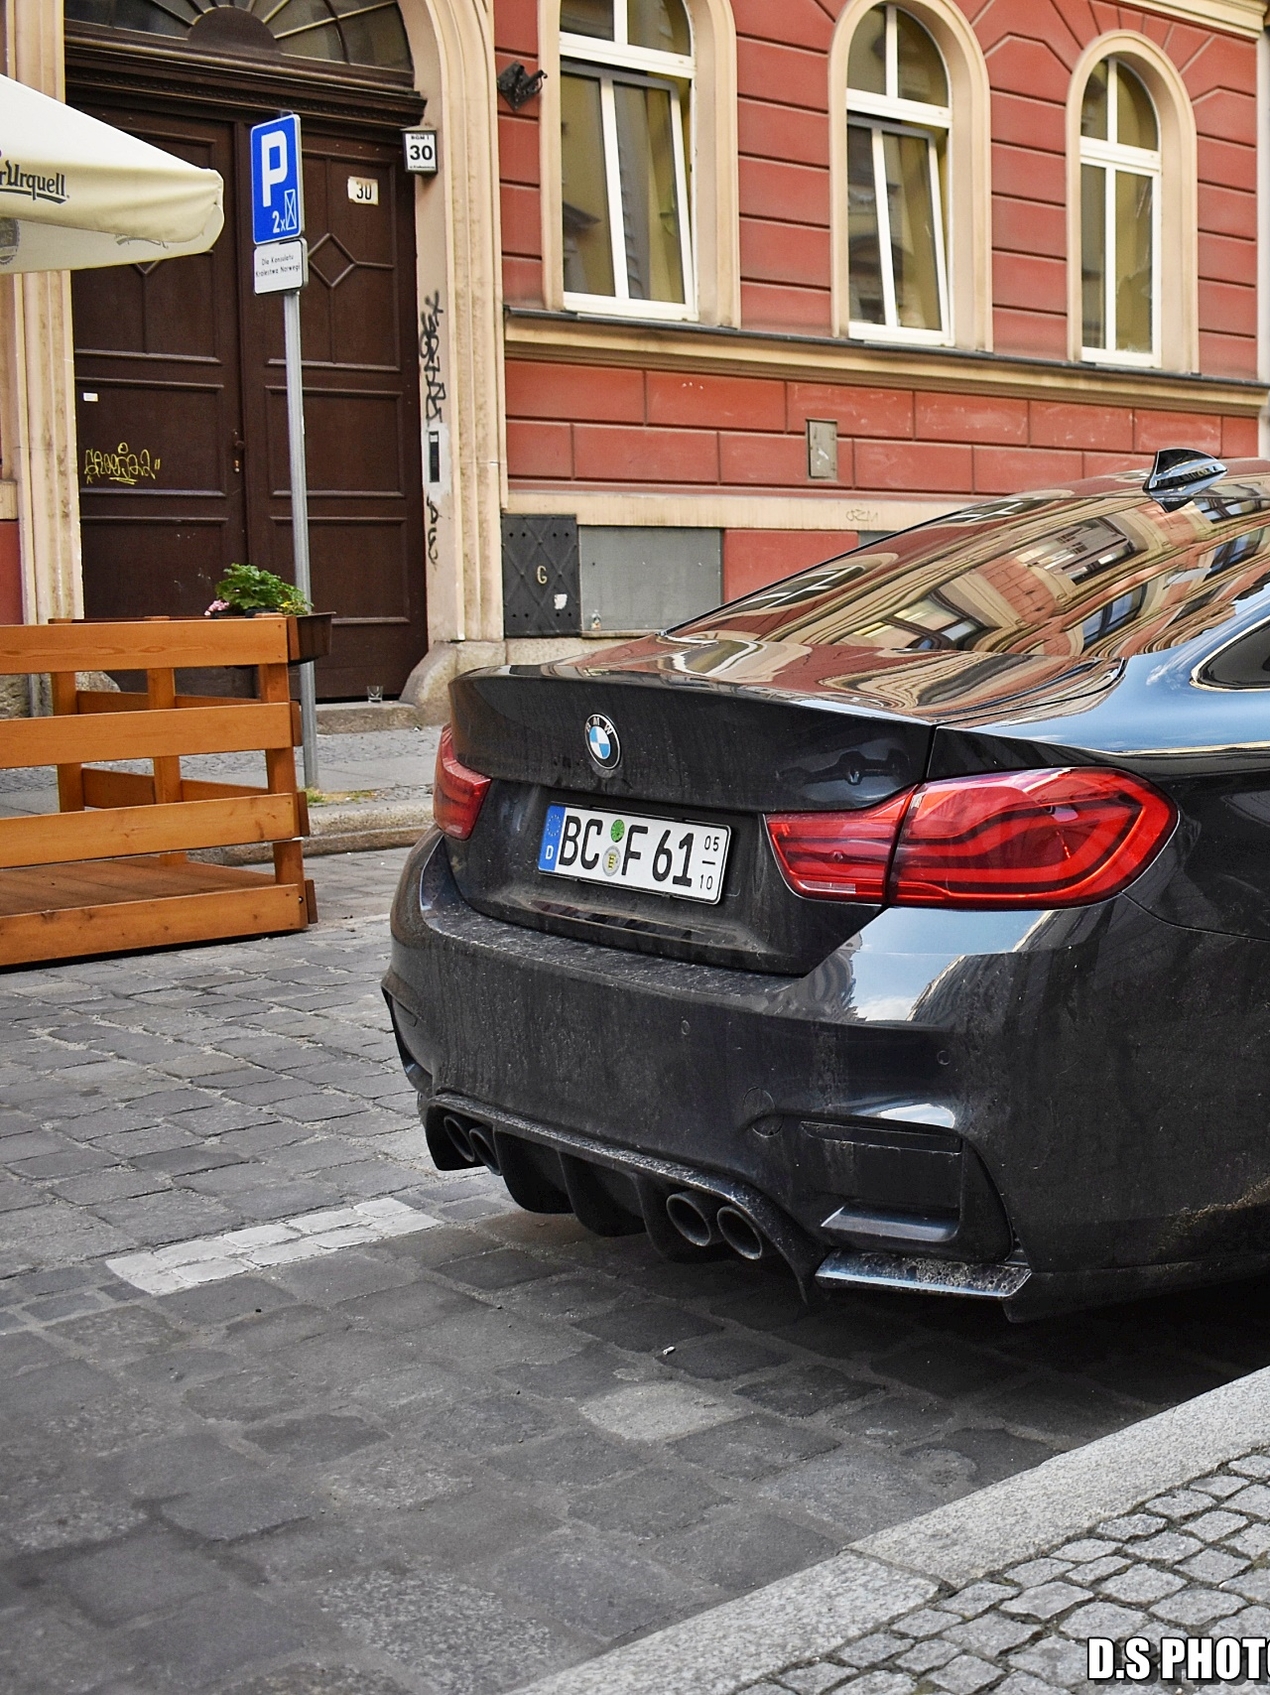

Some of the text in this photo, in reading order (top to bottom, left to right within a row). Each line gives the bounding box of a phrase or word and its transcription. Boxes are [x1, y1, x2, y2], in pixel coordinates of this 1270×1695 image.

[410, 145, 433, 161] 30
[261, 130, 288, 208] P
[5, 160, 66, 200] Urquell
[356, 181, 372, 200] 30
[536, 565, 548, 584] G
[586, 716, 614, 735] BMW
[545, 845, 554, 860] D
[558, 815, 695, 888] BC F 61
[704, 835, 720, 852] 05
[699, 873, 713, 890] 10
